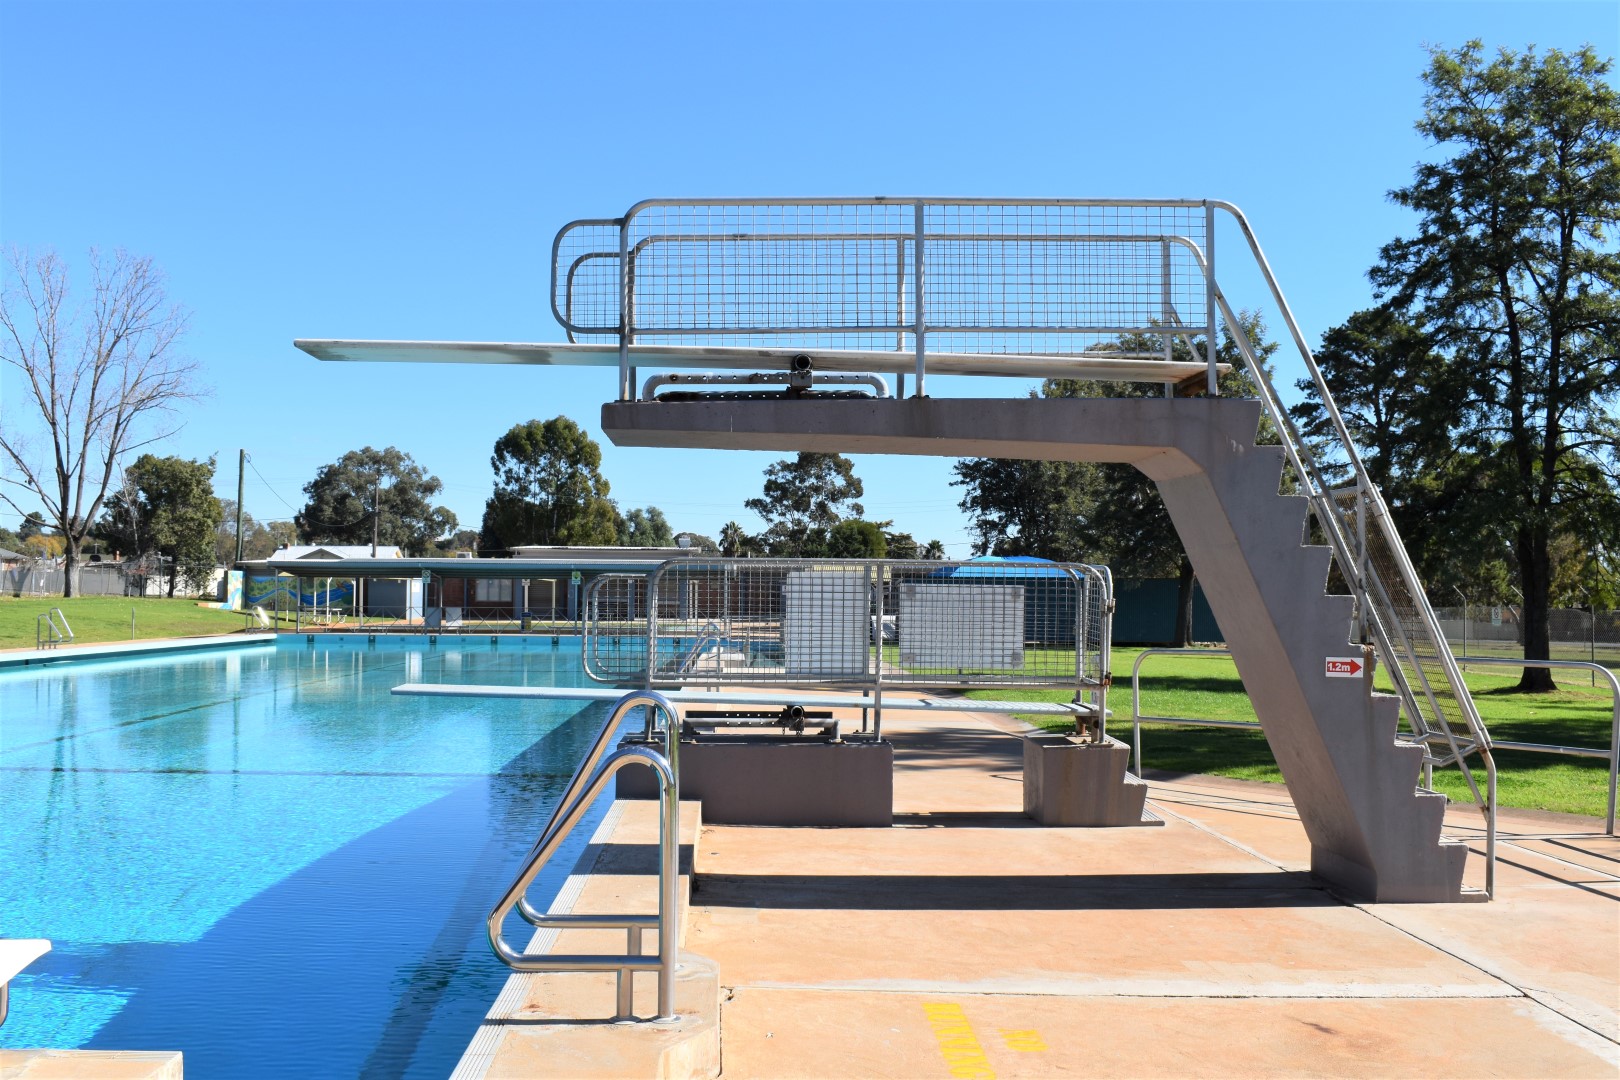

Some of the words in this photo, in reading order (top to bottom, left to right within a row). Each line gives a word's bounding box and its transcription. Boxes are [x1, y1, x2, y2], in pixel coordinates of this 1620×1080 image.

[1327, 662, 1350, 672] 1.2m
[921, 1003, 997, 1080] RUNNING
[998, 1028, 1049, 1052] NO
